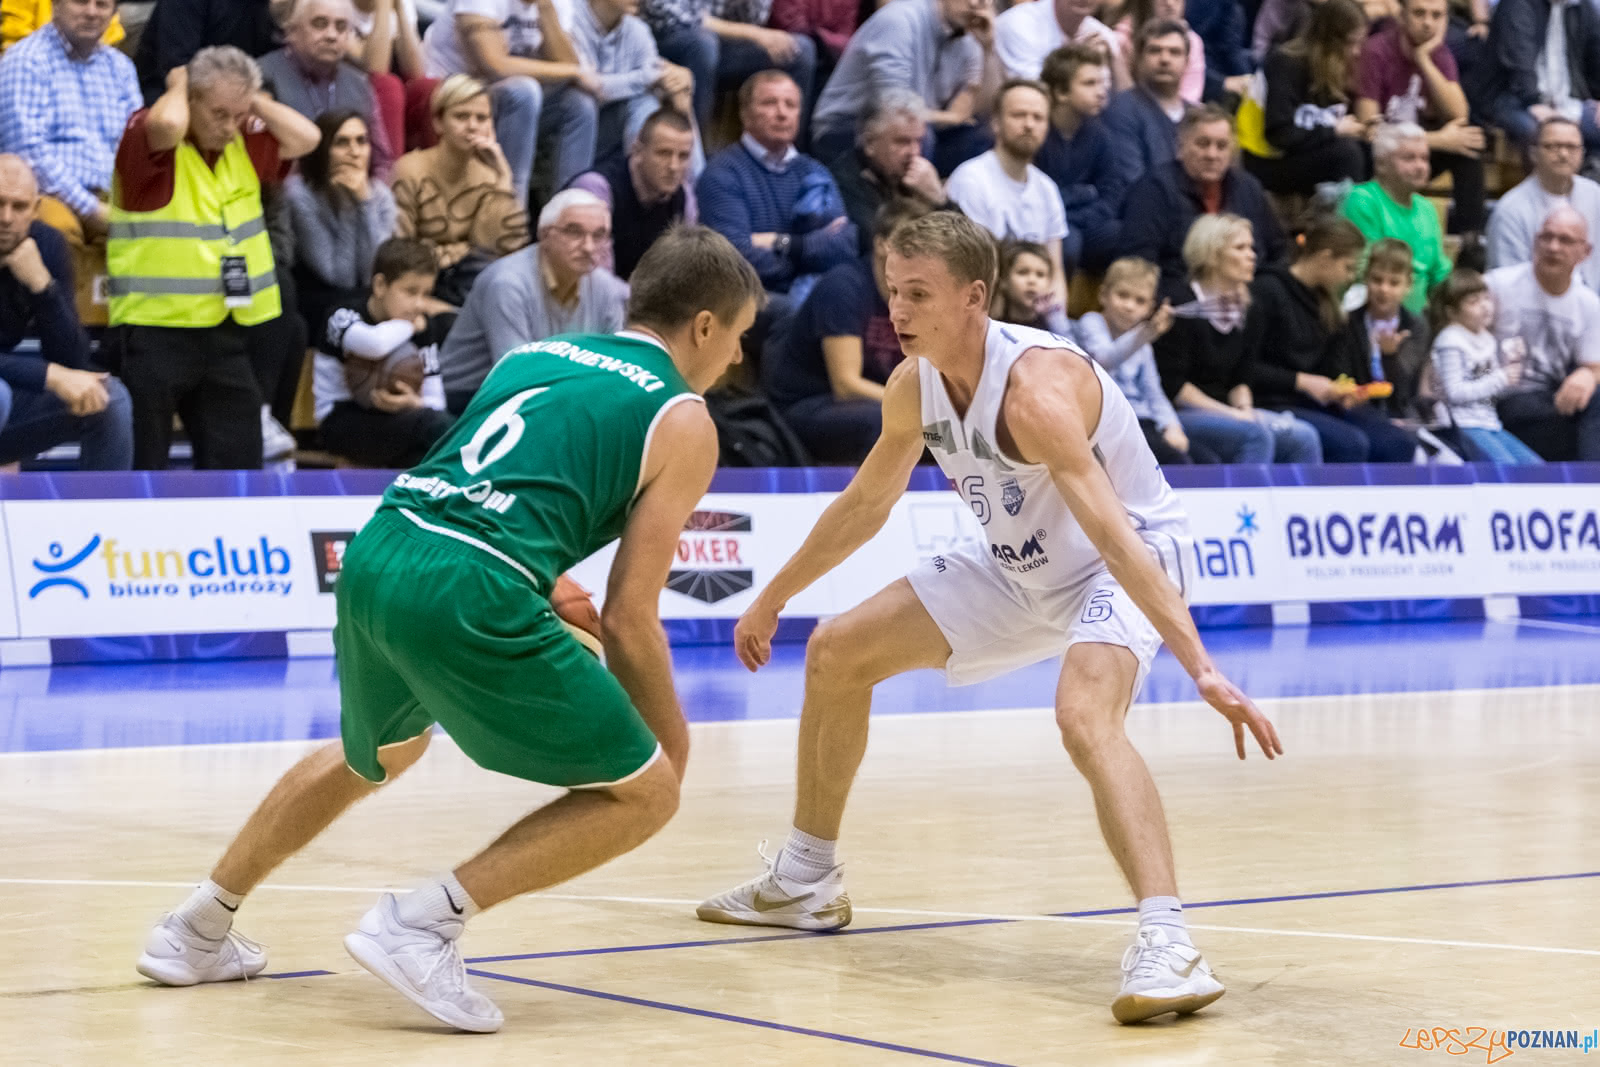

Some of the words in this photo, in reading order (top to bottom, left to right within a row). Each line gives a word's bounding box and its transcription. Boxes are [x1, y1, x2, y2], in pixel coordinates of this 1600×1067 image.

[460, 386, 551, 476] 6
[962, 475, 992, 526] 6
[1286, 512, 1465, 557] BIOFARM
[101, 535, 292, 579] funclub
[109, 582, 169, 597] biuro
[1081, 589, 1114, 624] 6
